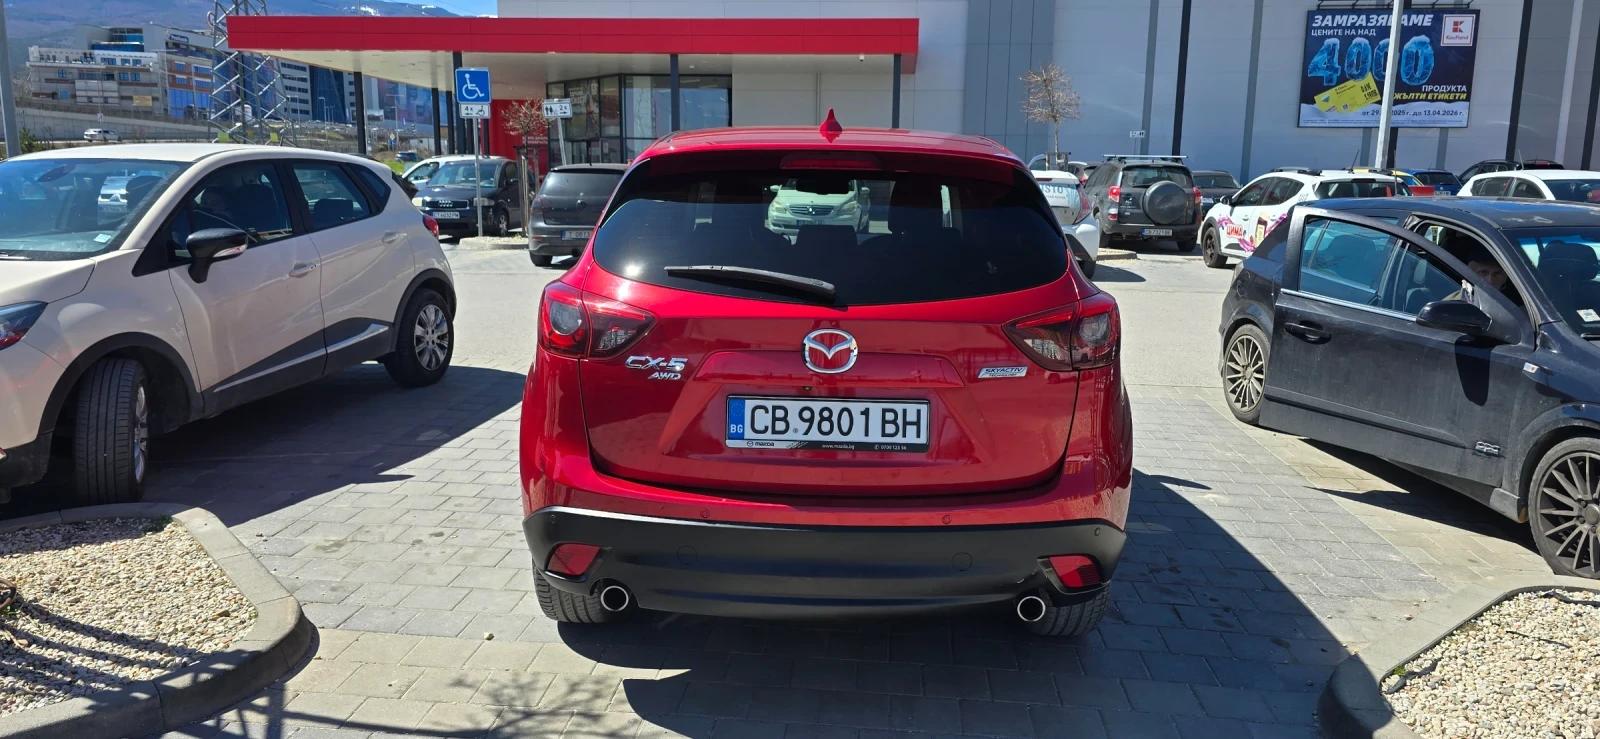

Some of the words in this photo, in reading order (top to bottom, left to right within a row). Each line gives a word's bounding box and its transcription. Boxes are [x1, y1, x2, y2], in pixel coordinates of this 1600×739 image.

[1357, 29, 1376, 37] НАД
[1421, 85, 1467, 93] ПРОДУКТА
[1393, 92, 1427, 100] ЖЪЛТИ
[1427, 92, 1467, 100] ЕТИКЕТИ
[624, 355, 689, 372] CX-5
[647, 371, 682, 380] AWD
[750, 404, 790, 435] CB
[797, 405, 870, 437] 9801
[881, 407, 922, 439] BH
[730, 424, 744, 433] BG
